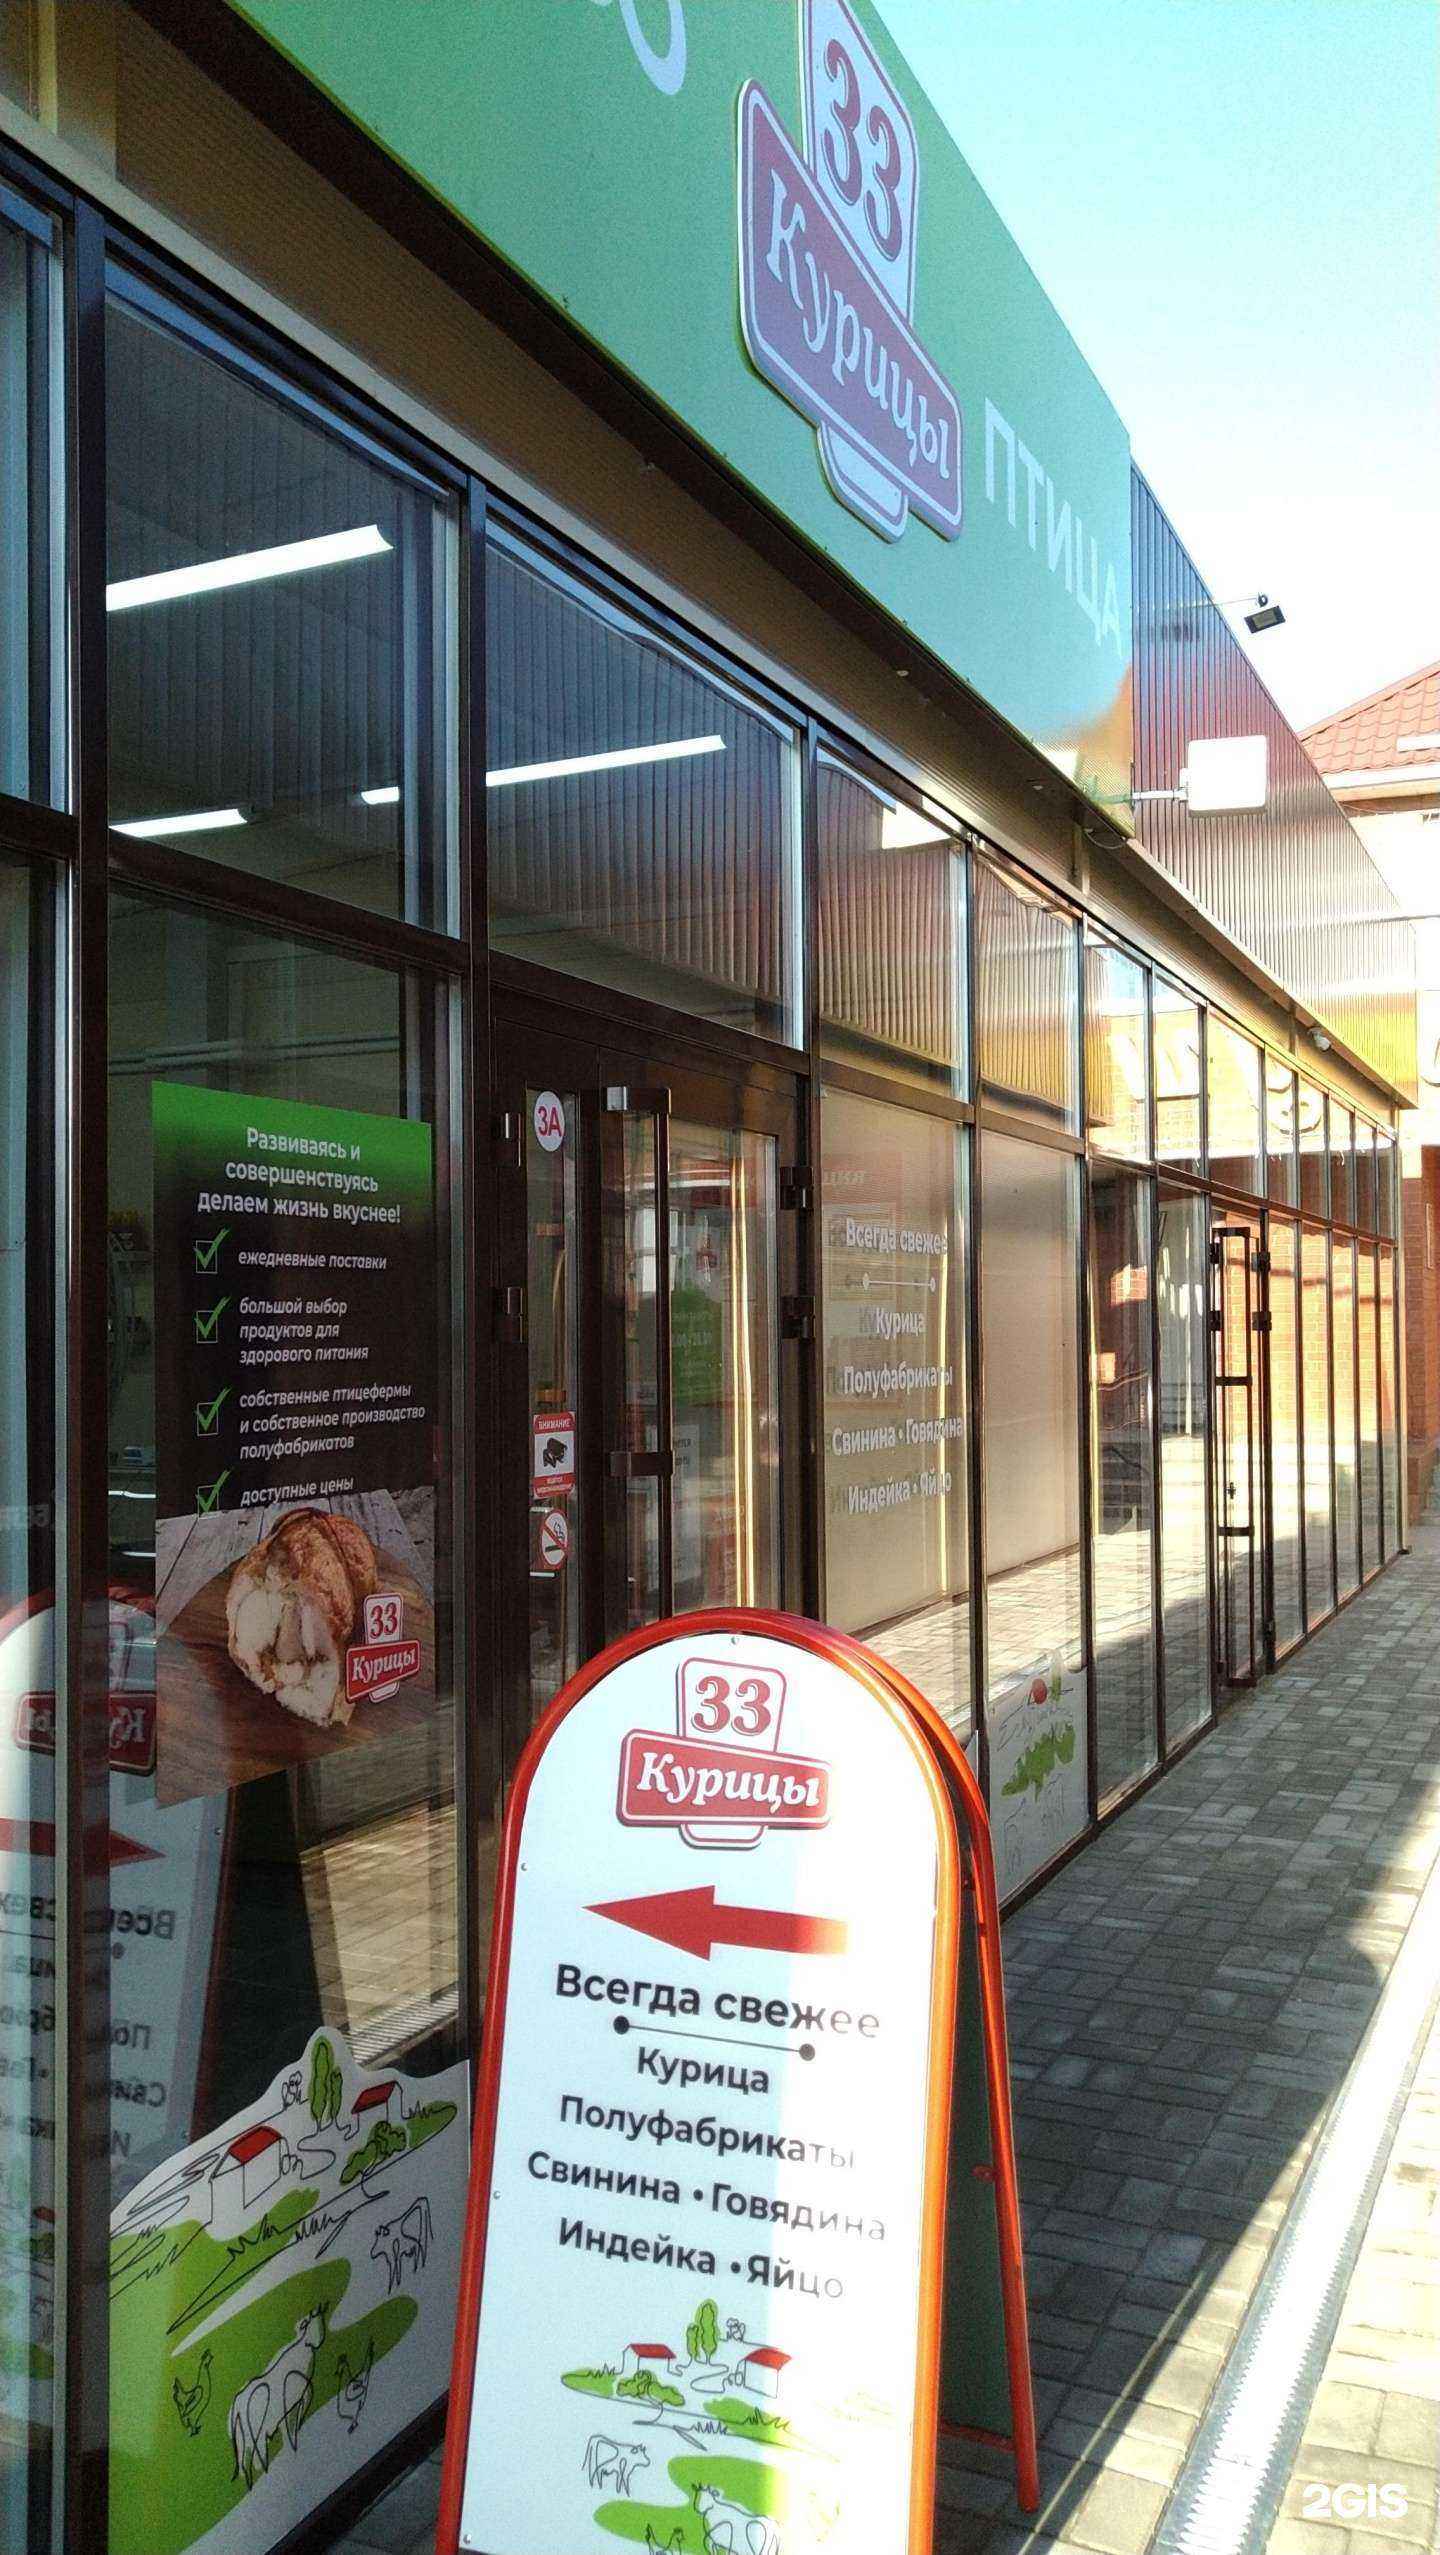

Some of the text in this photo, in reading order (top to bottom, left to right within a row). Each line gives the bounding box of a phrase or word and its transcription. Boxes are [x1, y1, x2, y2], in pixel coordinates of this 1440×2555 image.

[823, 38, 902, 262] 33
[766, 168, 950, 480] Курицы
[985, 397, 1123, 659] ПТИЦА
[247, 1127, 361, 1161] Развиваясь и
[226, 1161, 379, 1194] совершенствуясь
[197, 1192, 401, 1226] делаем жизнь вкуснее!
[846, 1216, 949, 1256] Всегда свежее
[238, 1250, 387, 1270] ежедневные поставки
[239, 1296, 348, 1318] большой выбор
[874, 1307, 926, 1341] Курица
[239, 1323, 340, 1343] продуктов для
[239, 1346, 369, 1368] здорового питания
[239, 1382, 412, 1408] собственные птицефермы
[239, 1406, 426, 1434] и собственное производство
[831, 1416, 963, 1457] Свинина Говядина
[239, 1435, 355, 1461] полуфабрикатов
[240, 1476, 354, 1507] доступные цены
[848, 1475, 911, 1515] Индейка
[370, 1602, 398, 1639] 33
[352, 1648, 416, 1683] Курицы
[691, 1675, 772, 1736] 33
[636, 1752, 820, 1814] Курицы
[556, 1963, 880, 2038] Всегда свежее
[637, 2046, 770, 2095] Курица
[560, 2094, 856, 2170] Полуфабрикаты
[527, 2150, 885, 2241] Свинина Говядина
[558, 2217, 844, 2299] Индейка Яйцо
